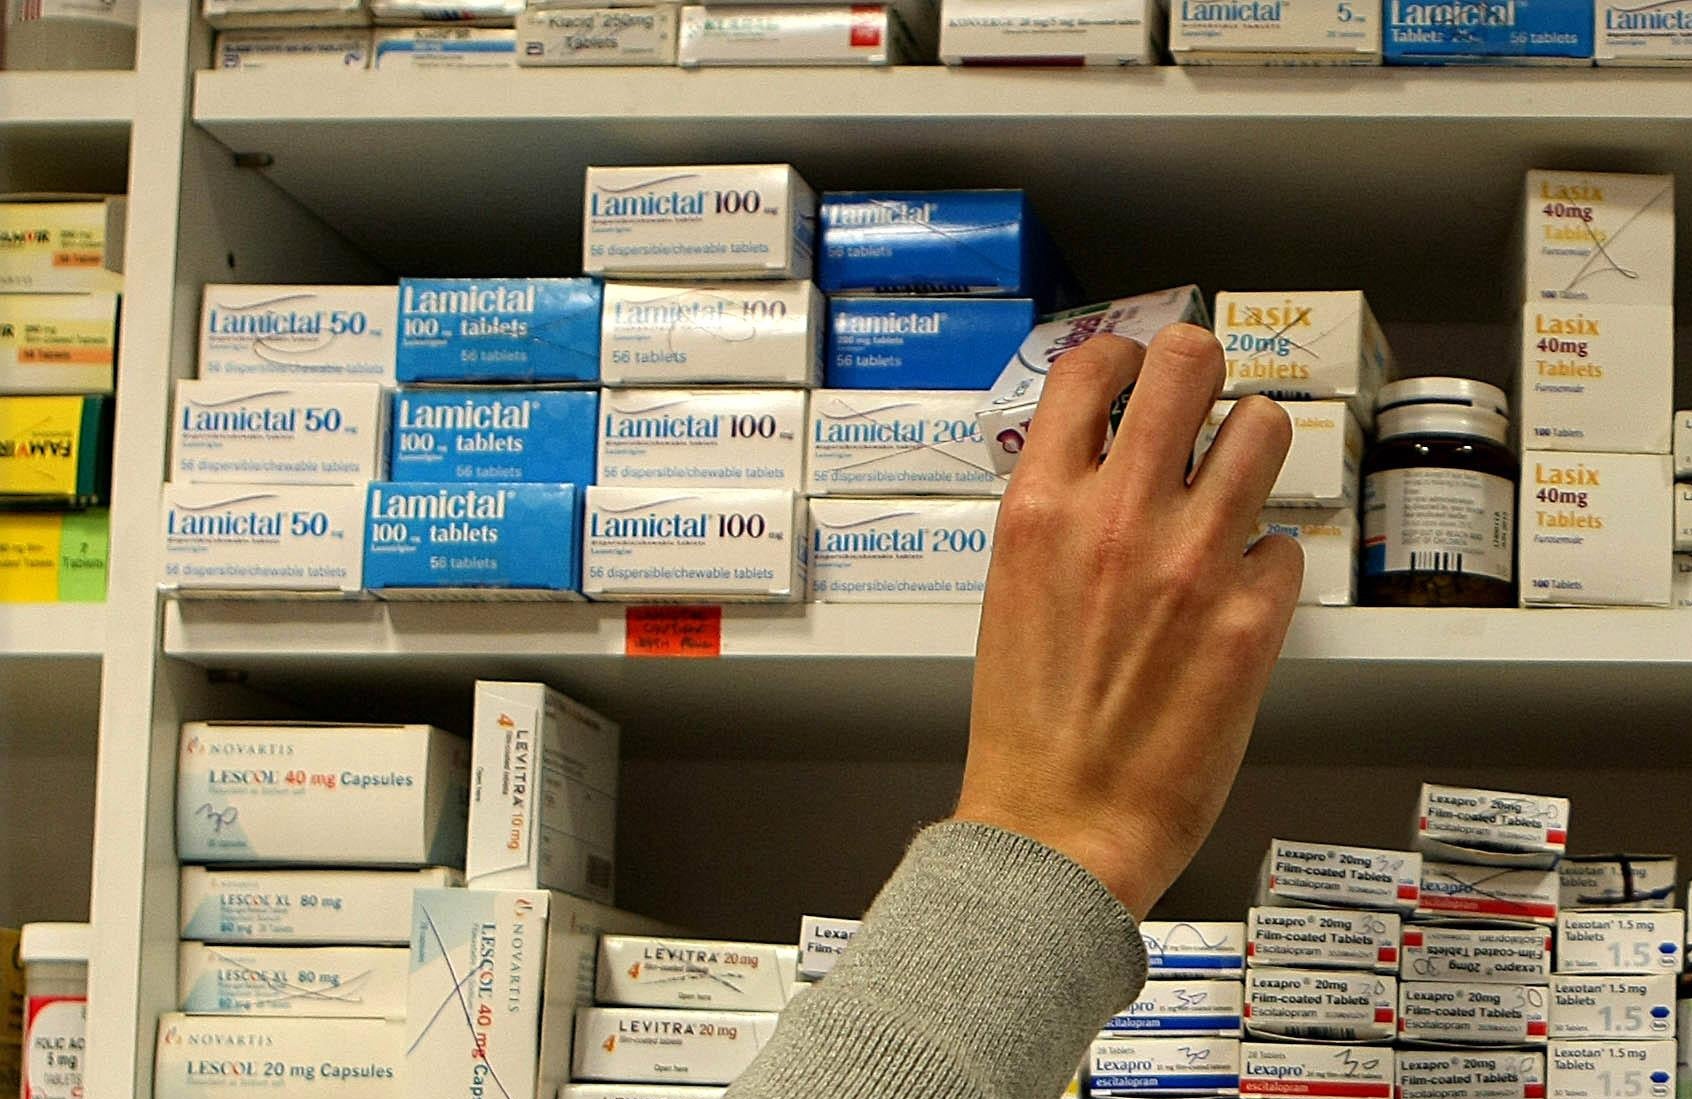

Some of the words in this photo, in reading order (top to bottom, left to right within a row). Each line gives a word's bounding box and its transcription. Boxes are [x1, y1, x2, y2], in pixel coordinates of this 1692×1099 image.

[590, 191, 705, 216] Lamictal
[714, 191, 760, 214] 100
[590, 244, 604, 255] 56
[732, 242, 769, 255] tablets
[1227, 301, 1312, 327] Lasix
[1536, 314, 1599, 335] Lasix
[1226, 334, 1290, 357] 20mg
[1537, 338, 1588, 358] 40mg
[1227, 360, 1310, 380] Tablets
[1537, 360, 1602, 378] Tablets
[182, 407, 296, 431] Lamictal
[305, 408, 341, 432] 50
[372, 490, 505, 519] Lamictal
[372, 524, 407, 542] 100
[430, 524, 498, 543] tablets
[590, 513, 708, 538] Lamictal
[718, 513, 765, 538] 100
[209, 743, 295, 756] NOVARTIS
[513, 729, 529, 808] LEVITRA
[209, 770, 278, 786] LESCOL
[285, 771, 307, 786] 40
[311, 774, 336, 789] mg
[341, 773, 413, 788] Capsules
[1258, 915, 1305, 928] Lexapro
[1320, 918, 1352, 931] 20mg
[1566, 919, 1611, 930] Lexotan
[1618, 920, 1633, 930] 1.5
[1636, 922, 1655, 932] mg
[1256, 930, 1328, 942] Film-coated
[1332, 933, 1373, 945] Tablets
[1566, 931, 1604, 942] Tablets
[1256, 944, 1321, 956] Escitalopram
[1607, 942, 1650, 967] 1.5
[509, 923, 524, 1014] NOVARTIS
[620, 1020, 695, 1035] LEVITRA
[699, 1023, 714, 1036] 20
[717, 1025, 737, 1040] mg
[1096, 1060, 1151, 1073] Lexapro
[1096, 1077, 1158, 1087] escitalopram
